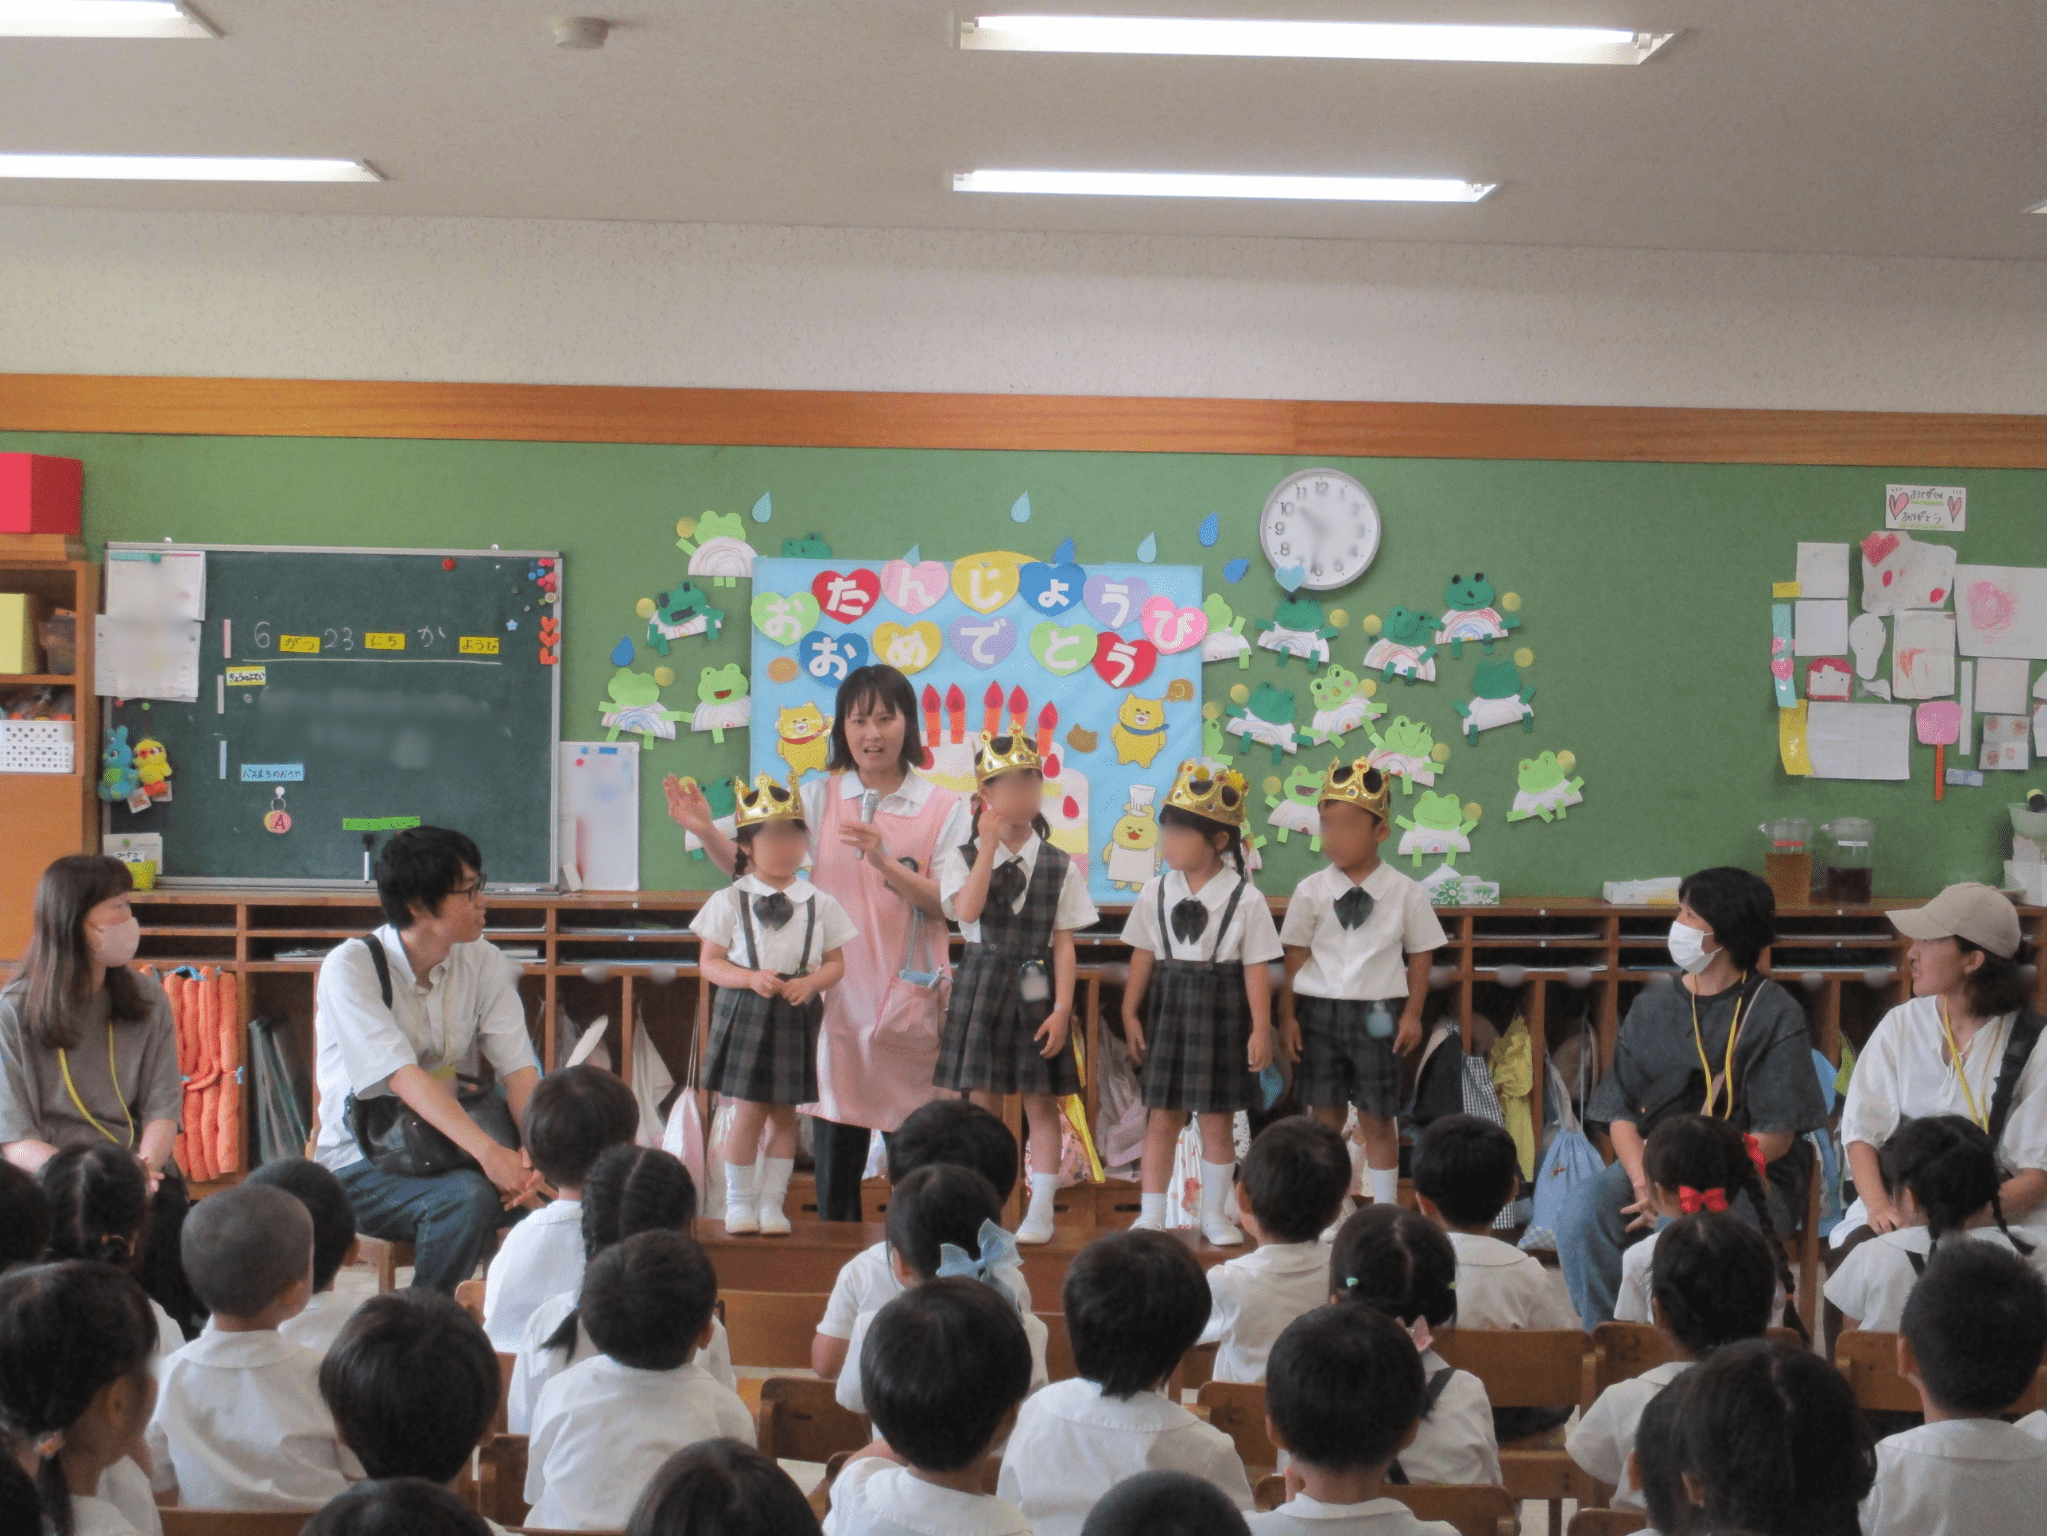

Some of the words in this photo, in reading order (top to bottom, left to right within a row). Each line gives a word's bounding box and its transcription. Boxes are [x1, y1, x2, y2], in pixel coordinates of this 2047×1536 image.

[1295, 485, 1308, 501] 11
[1314, 480, 1330, 497] 12
[1280, 501, 1295, 516] 10
[1902, 510, 1942, 524] ありがとう
[1274, 521, 1285, 536] 9
[1279, 541, 1290, 556] 8
[764, 567, 1195, 650] おたんじょうび
[254, 621, 270, 649] 6
[284, 636, 316, 651] がつ
[324, 627, 354, 651] 23
[370, 634, 398, 648] にち
[417, 625, 447, 648] か
[809, 617, 1138, 688] おめでとう
[273, 813, 287, 830] A
